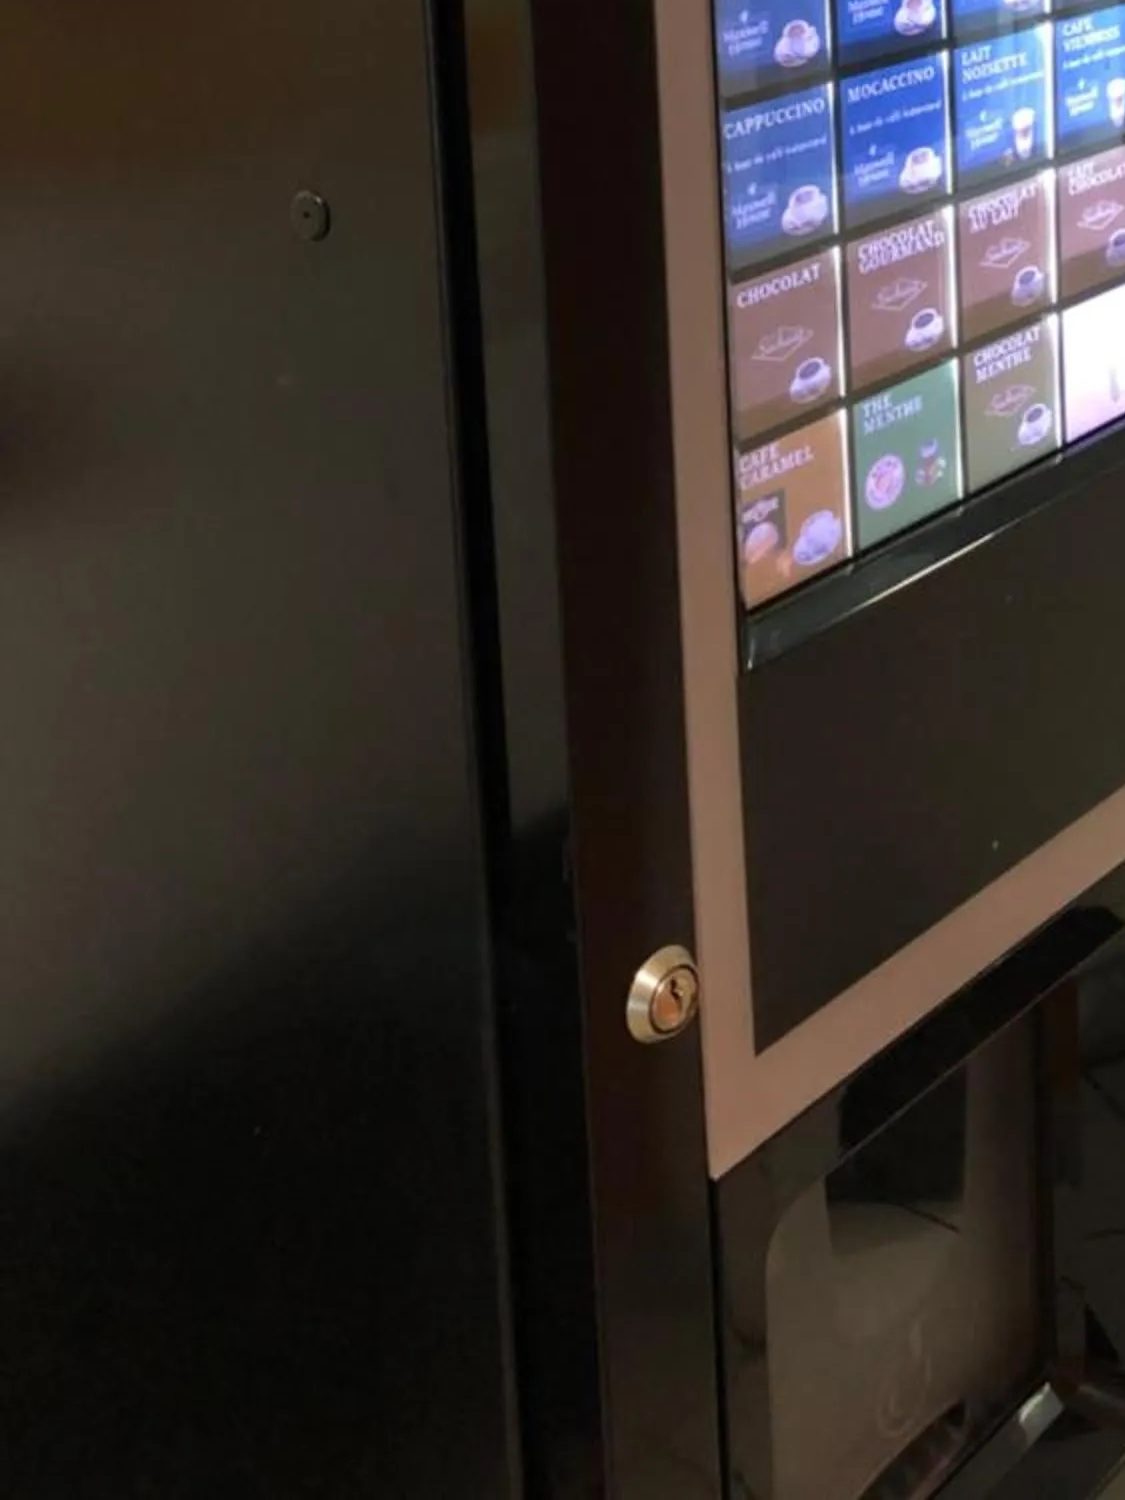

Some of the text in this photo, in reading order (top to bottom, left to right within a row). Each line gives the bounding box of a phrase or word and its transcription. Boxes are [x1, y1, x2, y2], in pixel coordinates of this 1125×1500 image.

[846, 64, 936, 104] MOCACCINO
[722, 97, 826, 141] CAPPUCCINO
[736, 262, 822, 309] CHOCOLAT
[740, 445, 815, 491] CARAMEL
